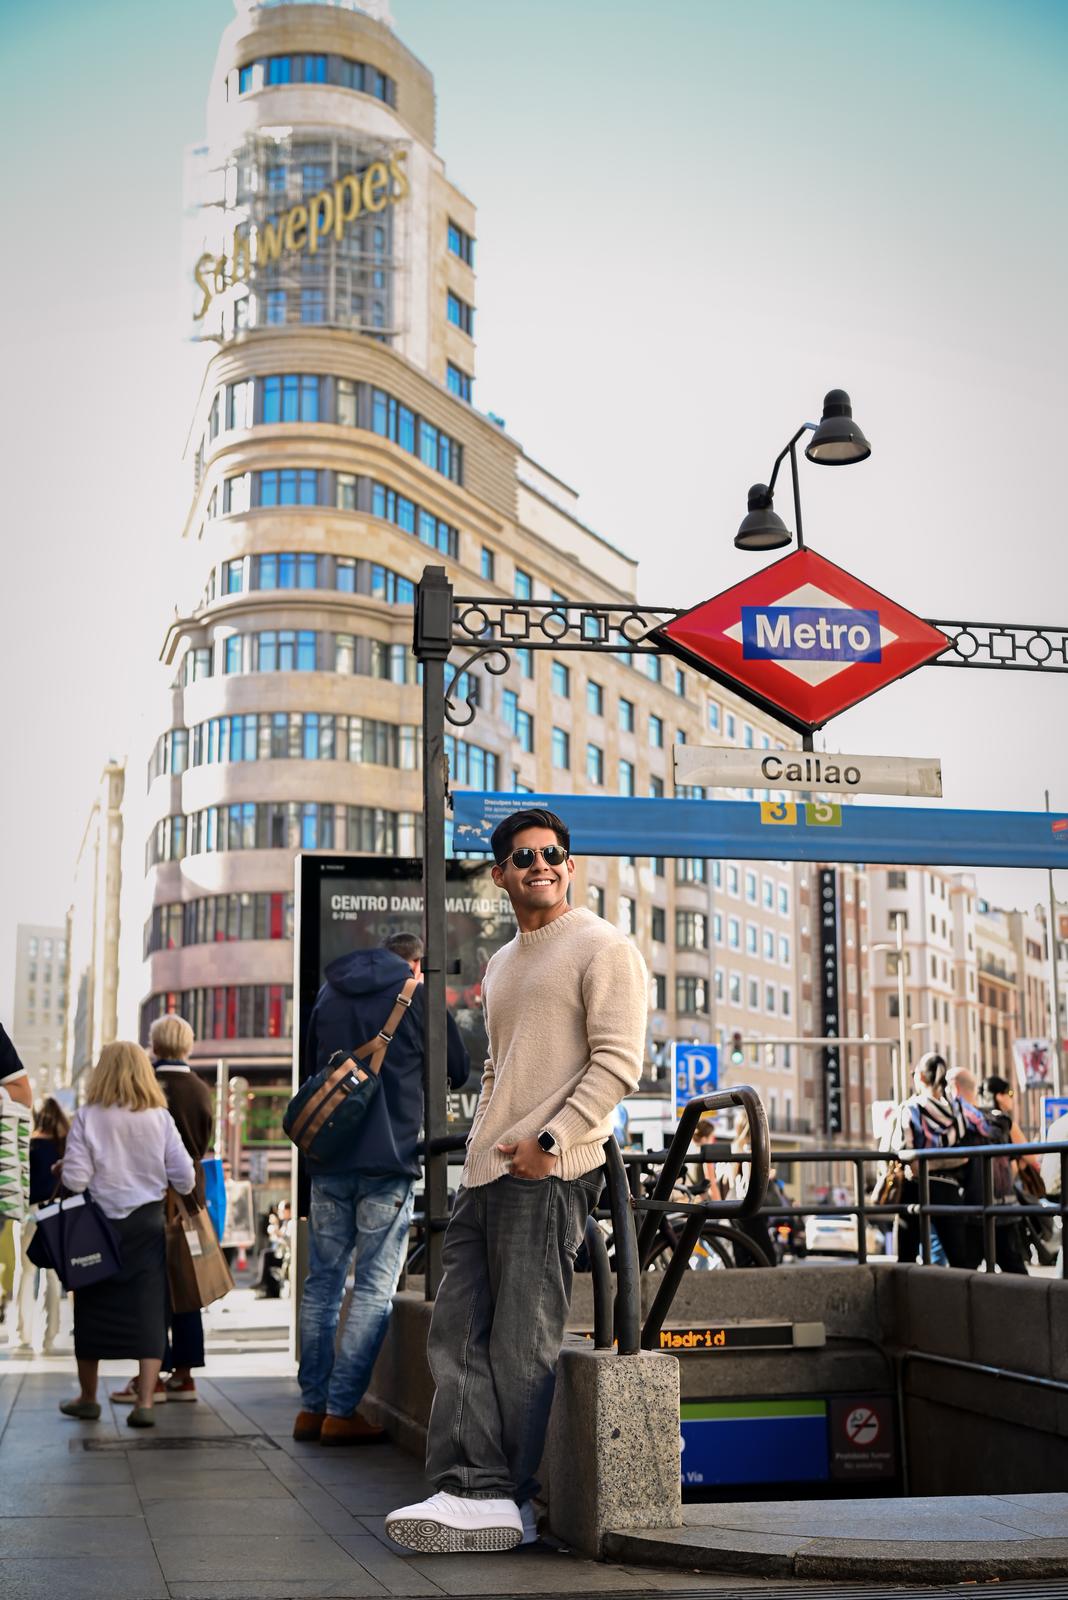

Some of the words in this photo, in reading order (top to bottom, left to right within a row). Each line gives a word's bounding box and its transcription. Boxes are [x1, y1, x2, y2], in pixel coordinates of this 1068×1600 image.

[755, 613, 871, 651] Metro
[761, 756, 861, 785] Callao
[770, 800, 787, 821] 3
[814, 801, 833, 822] 5
[331, 895, 388, 911] CENTRO
[390, 896, 424, 912] DAN
[822, 872, 834, 927] ROOM
[824, 943, 835, 998] MATE
[660, 1330, 725, 1348] Madrid
